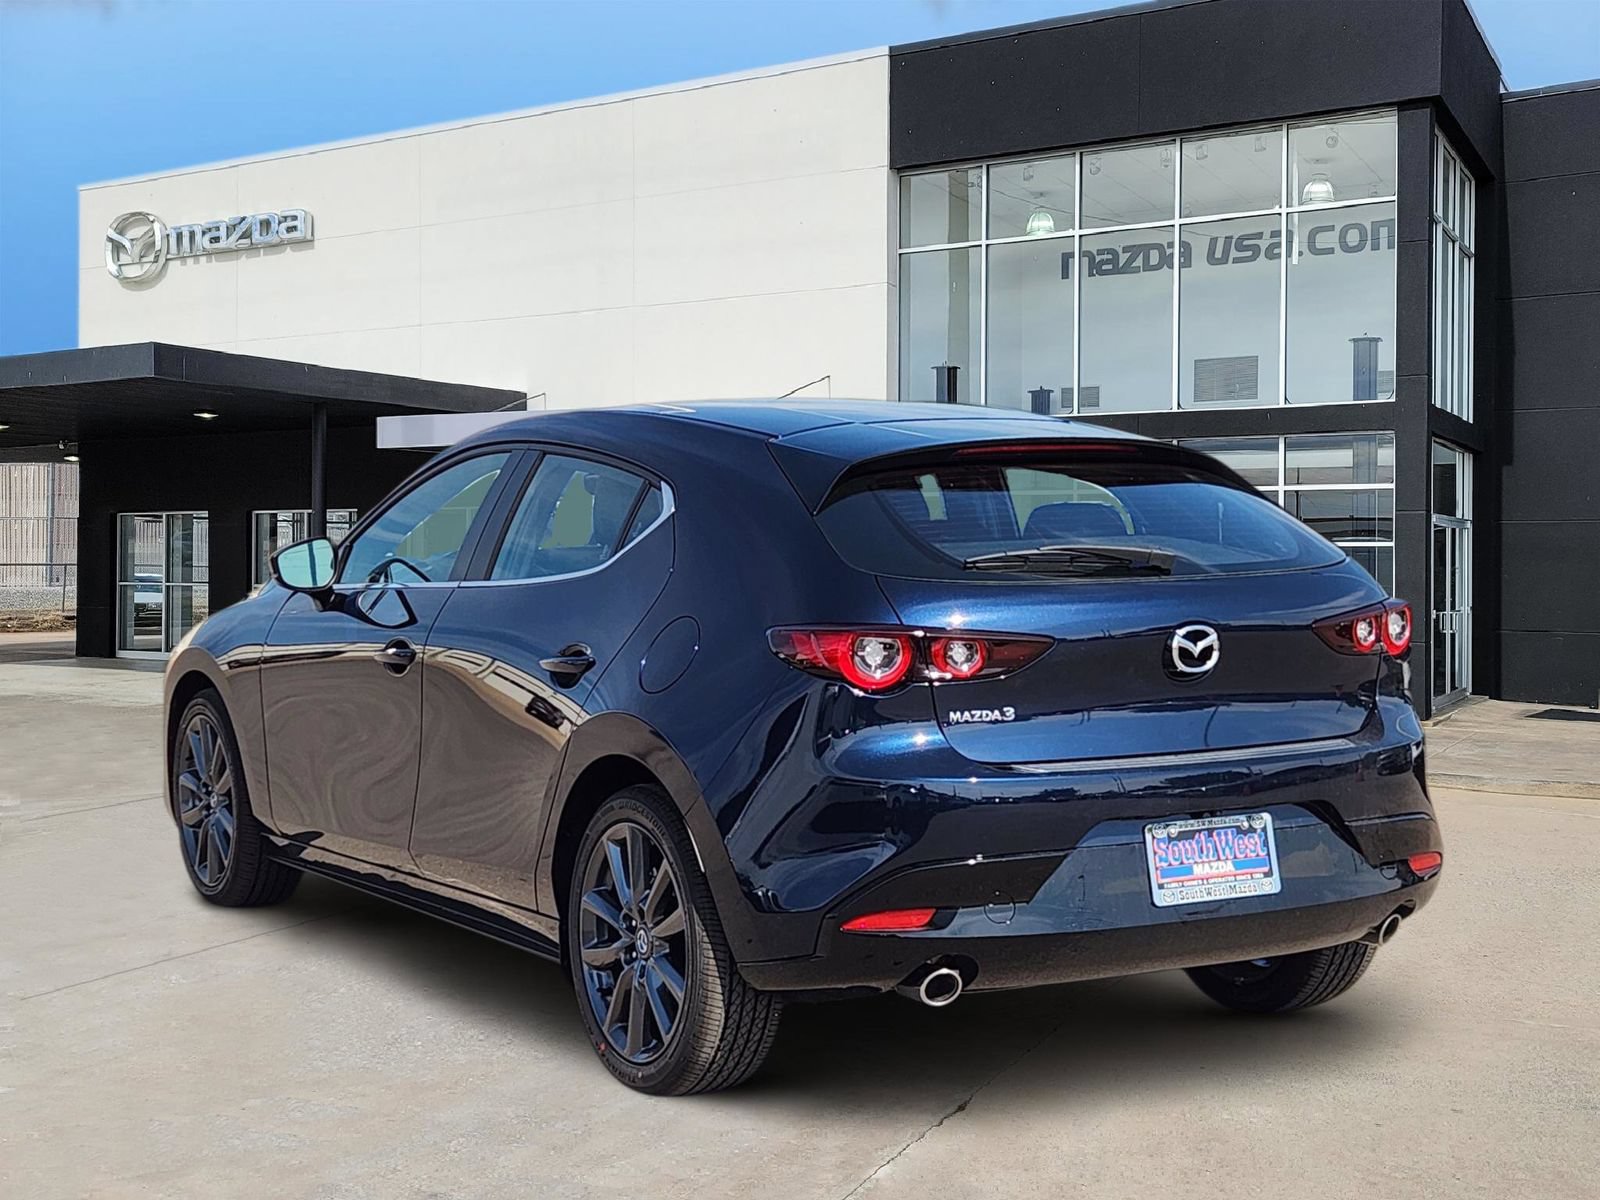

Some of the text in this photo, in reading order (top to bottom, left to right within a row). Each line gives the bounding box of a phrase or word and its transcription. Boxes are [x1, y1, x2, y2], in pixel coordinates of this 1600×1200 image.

[167, 208, 313, 258] mazda
[1061, 239, 1192, 280] mazda
[1154, 828, 1268, 867] SouthWest
[1193, 860, 1236, 875] MAZDA
